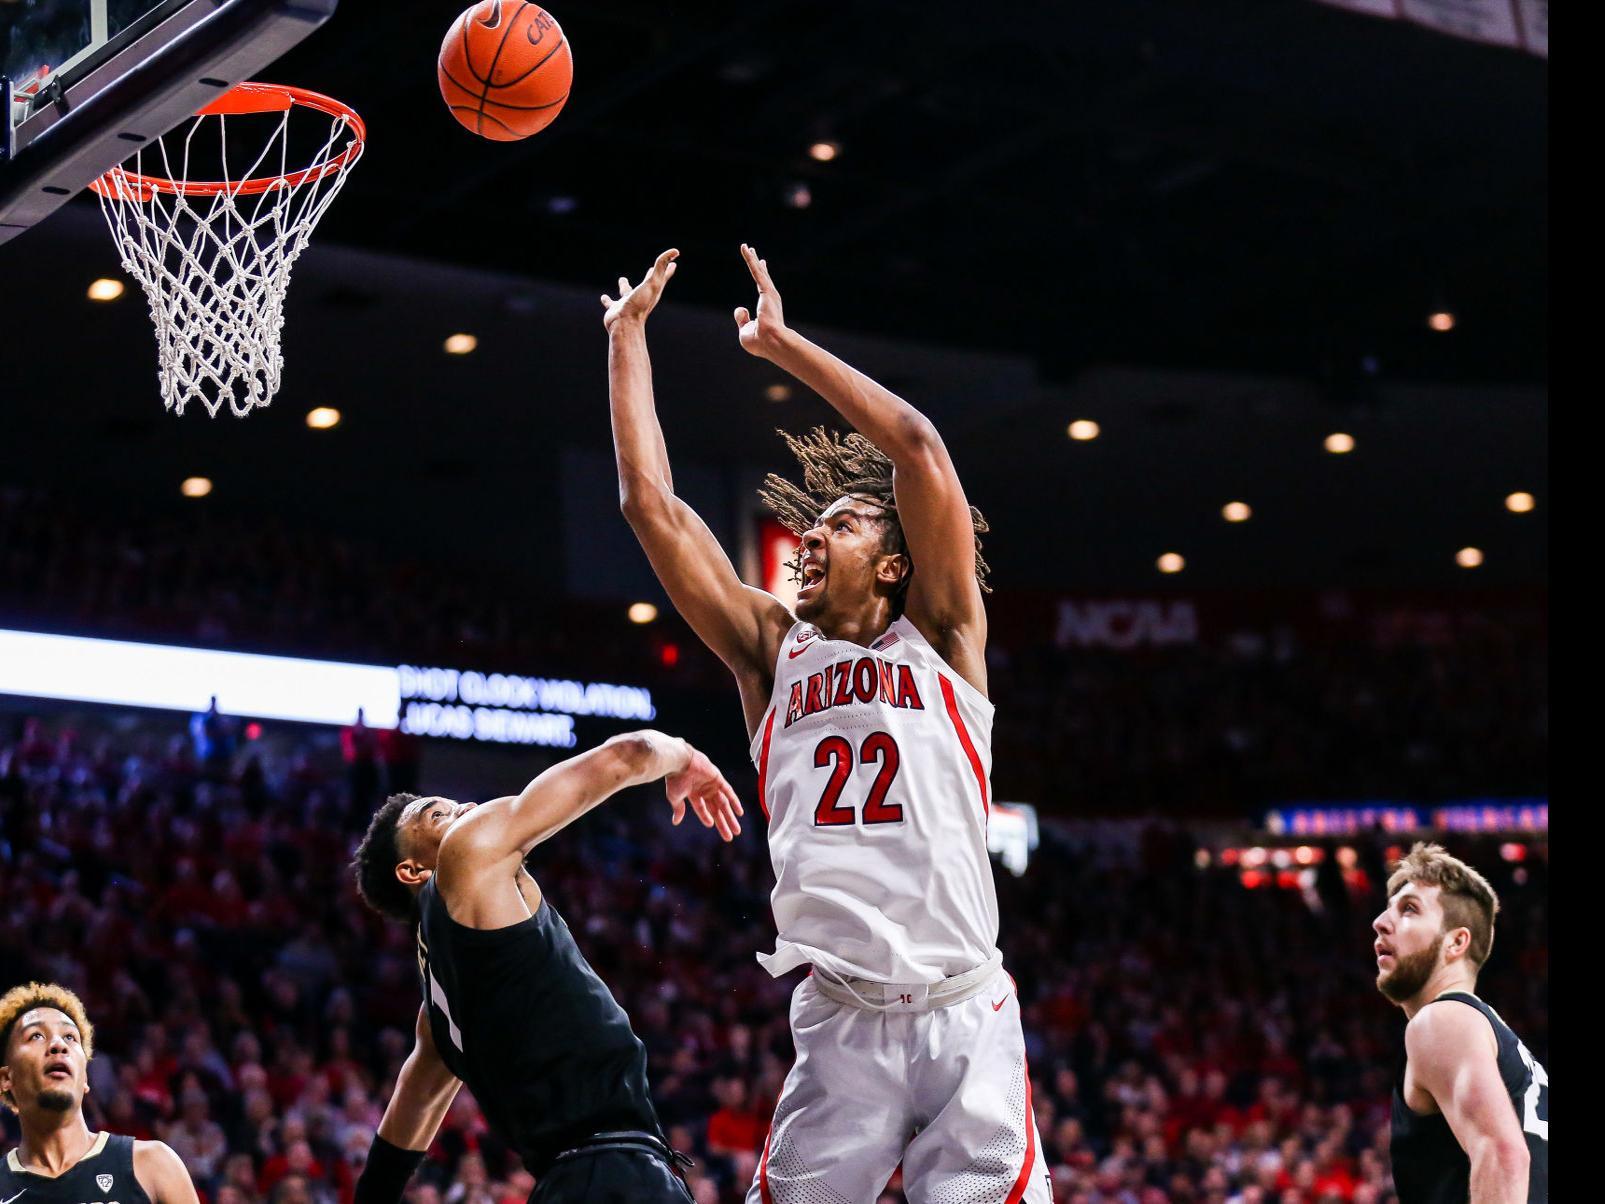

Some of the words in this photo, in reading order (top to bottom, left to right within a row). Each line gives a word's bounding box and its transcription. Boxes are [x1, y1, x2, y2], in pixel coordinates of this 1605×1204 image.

[1056, 601, 1197, 648] NCAA
[458, 671, 540, 710] CLOCK
[784, 657, 925, 729] ARIZONA
[813, 731, 904, 827] 22
